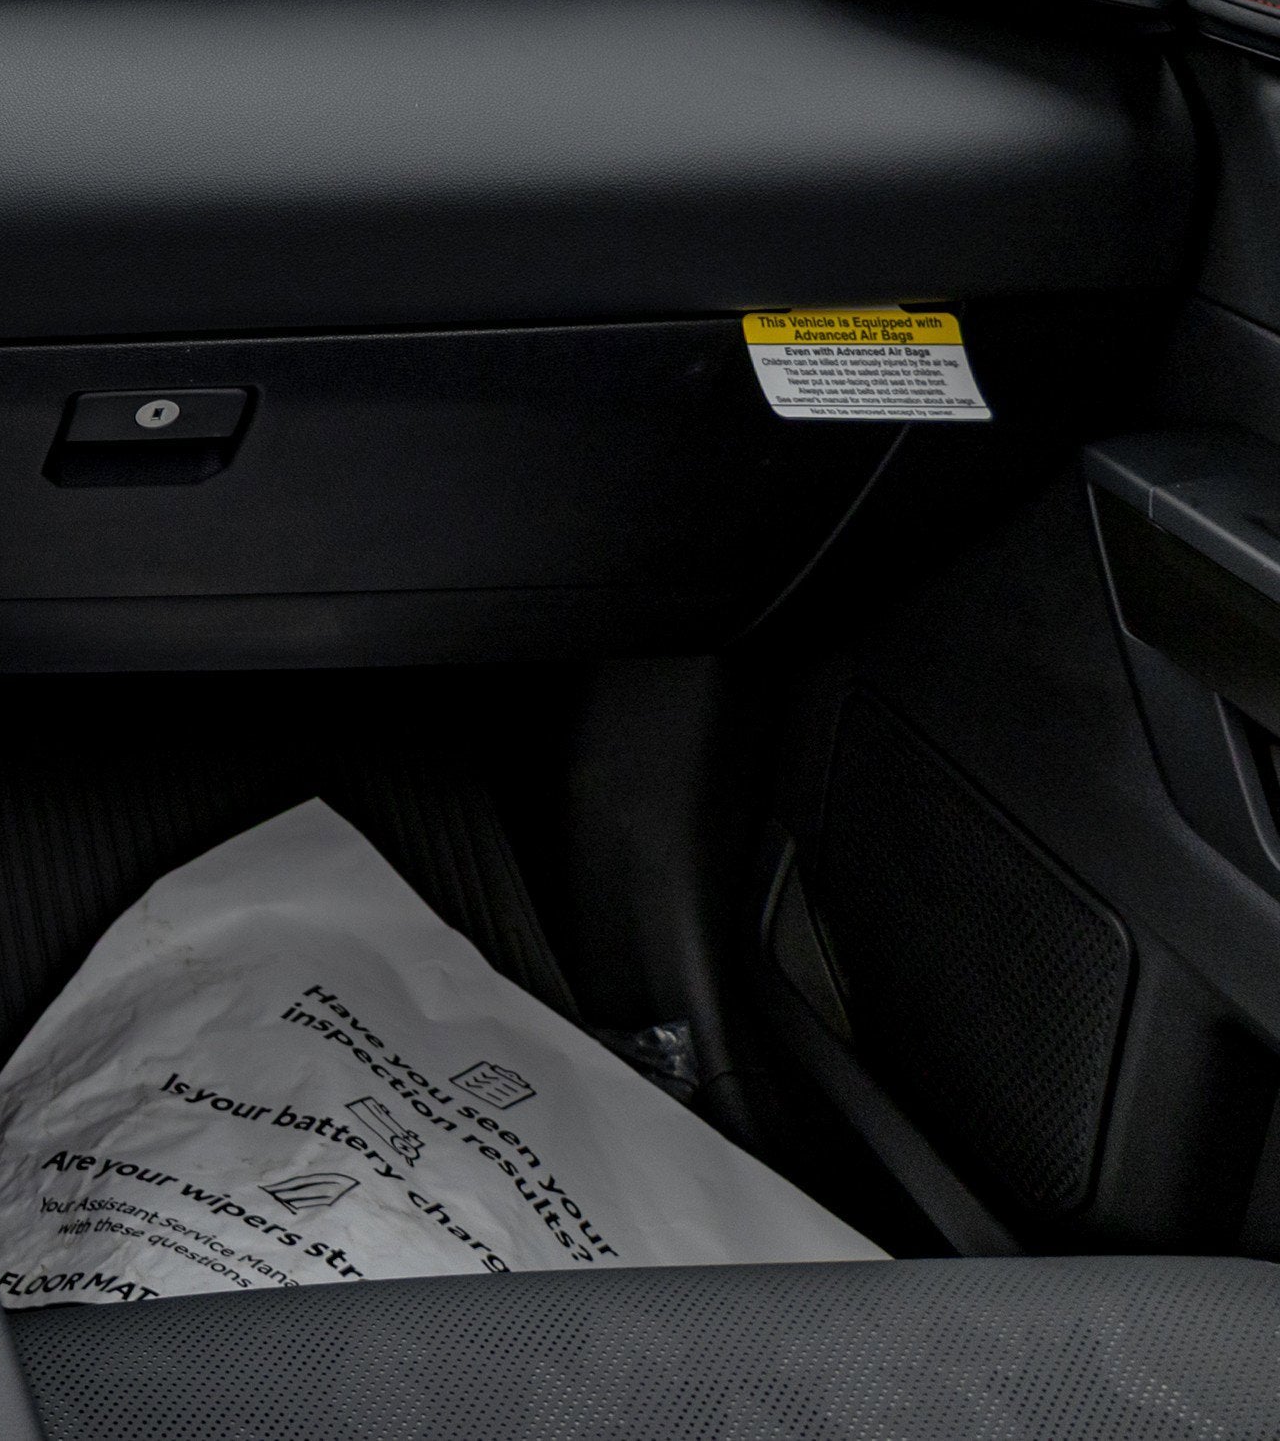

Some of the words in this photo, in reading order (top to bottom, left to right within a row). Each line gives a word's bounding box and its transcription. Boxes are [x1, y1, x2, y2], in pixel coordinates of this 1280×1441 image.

[758, 316, 786, 329] This
[790, 316, 835, 328] Vehicle
[839, 316, 850, 328] is
[853, 316, 913, 331] Equipped
[915, 316, 942, 328] with
[784, 346, 810, 357] Even
[812, 346, 834, 357] with
[836, 346, 886, 357] Advanced
[888, 346, 902, 357] Air
[905, 346, 930, 359] Bags
[794, 329, 857, 342] Advanced
[860, 329, 878, 342] Air
[882, 330, 914, 344] Bags
[159, 1073, 190, 1095] Is
[190, 1088, 273, 1122] your
[271, 1105, 406, 1182] battery
[280, 1002, 458, 1132] inspection
[462, 1134, 595, 1263] results?
[302, 984, 386, 1049] Have
[383, 1054, 455, 1106] you
[456, 1106, 543, 1169] seen
[538, 1174, 621, 1258] your
[40, 1196, 78, 1214] Your
[78, 1196, 160, 1225] Assistant
[159, 1216, 236, 1258] Service
[41, 1150, 97, 1172] Are
[93, 1158, 179, 1187] your
[180, 1183, 304, 1247] wipers
[57, 1218, 92, 1236] with
[93, 1217, 146, 1239] these
[146, 1233, 253, 1290] questions
